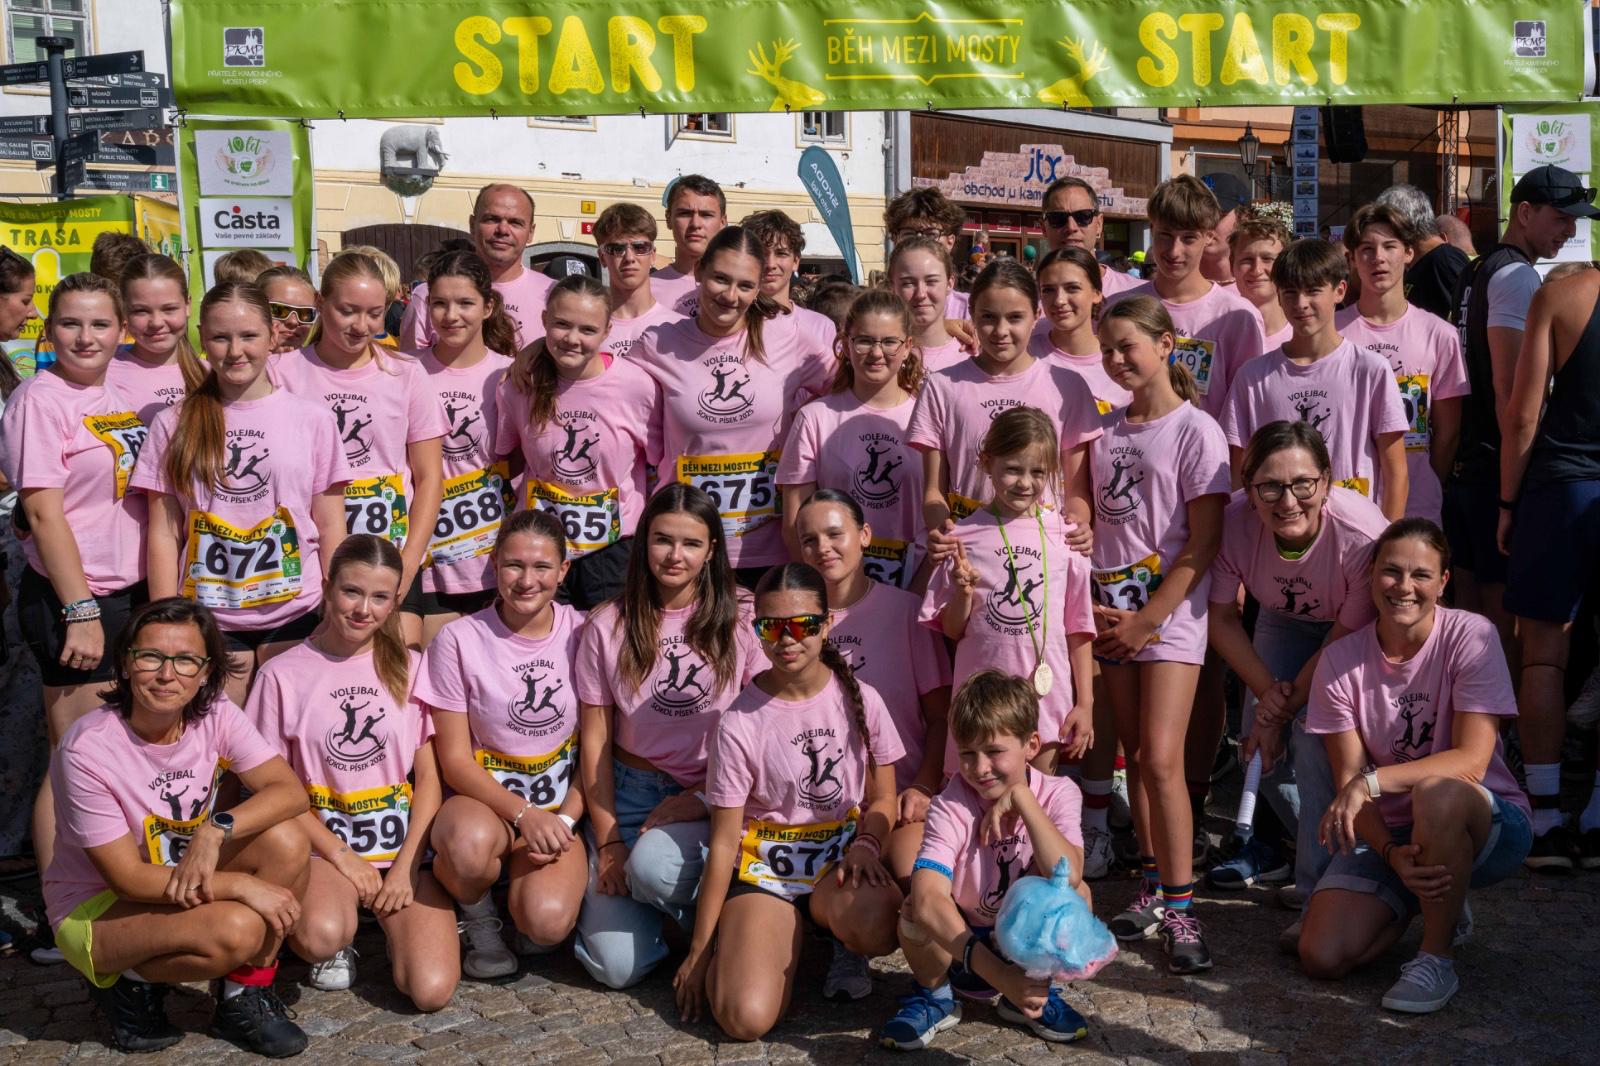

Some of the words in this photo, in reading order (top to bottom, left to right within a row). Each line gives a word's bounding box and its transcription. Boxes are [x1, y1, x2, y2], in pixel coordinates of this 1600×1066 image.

[225, 44, 264, 57] PKMP
[827, 27, 873, 64] BĚH
[881, 35, 937, 64] MEZI
[946, 34, 1021, 65] MOSTY
[1137, 12, 1361, 88] START
[453, 15, 708, 95] START
[1535, 120, 1550, 137] 10
[1550, 119, 1571, 137] let
[227, 136, 244, 154] 10
[245, 136, 270, 156] let
[1024, 147, 1062, 184] jtx
[964, 182, 1005, 199] obchod
[1008, 188, 1016, 199] u
[69, 207, 102, 218] MOSTY
[9, 228, 81, 246] TRASA
[233, 232, 254, 240] pevné
[255, 232, 281, 241] základy
[1365, 342, 1399, 353] OLEJBAL
[323, 392, 368, 404] VOLEJBAL
[439, 391, 476, 402] OLEJBAL
[1287, 389, 1328, 402] VOLEJBAL
[557, 410, 597, 422] VOLEJBAL
[696, 409, 718, 424] SOKOL
[718, 415, 738, 425] PÍSEK
[738, 408, 755, 422] 2025
[225, 429, 265, 439] OLEJBAL
[858, 432, 900, 446] VOLEJBAL
[1109, 446, 1144, 459] VOLEJBAL
[355, 455, 371, 469] 2025
[682, 460, 699, 472] BĚH
[701, 463, 722, 473] MEZI
[723, 461, 753, 472] MOSTY
[230, 493, 252, 504] PÍSEK
[253, 488, 270, 502] 2025
[345, 486, 367, 496] OSTY
[445, 480, 475, 496] MOSTY
[700, 476, 771, 510] 675
[866, 500, 885, 510] PÍSEK
[884, 496, 900, 509] 2025
[344, 501, 388, 534] 78
[433, 491, 502, 538] 668
[1122, 512, 1137, 523] 2025
[209, 522, 233, 536] MEZI
[205, 537, 279, 580] 672
[994, 545, 1042, 561] VOLEJBAL
[864, 561, 903, 590] 61
[1273, 575, 1312, 590] VOLEJBAL
[985, 614, 1003, 634] SOKOL
[1004, 624, 1024, 636] PÍSEK
[511, 659, 555, 673] VOLEJBAL
[330, 686, 379, 701] VOLEJBAL
[1391, 692, 1430, 709] VOLEJBAL
[650, 701, 673, 717] SOKOL
[674, 707, 694, 718] PÍSEK
[694, 697, 712, 714] 2025
[505, 721, 527, 737] SOKOL
[528, 727, 548, 737] PÍSEK
[549, 720, 565, 734] 2025
[790, 727, 836, 747] VOLEJBAL
[324, 756, 348, 772] SOKOL
[349, 762, 369, 773] PÍSEK
[370, 752, 387, 766] 2025
[483, 754, 502, 767] BĚH
[504, 760, 526, 771] MEZI
[528, 756, 561, 774] MOSTY
[148, 769, 195, 791] VOLEJBAL
[501, 763, 574, 806] 681
[309, 791, 325, 806] BĚH
[327, 795, 347, 808] MEZI
[347, 797, 380, 812] MOSTY
[149, 818, 169, 834] BĚH
[325, 814, 405, 852] 659
[756, 827, 776, 839] BĚH
[778, 830, 803, 841] MEZI
